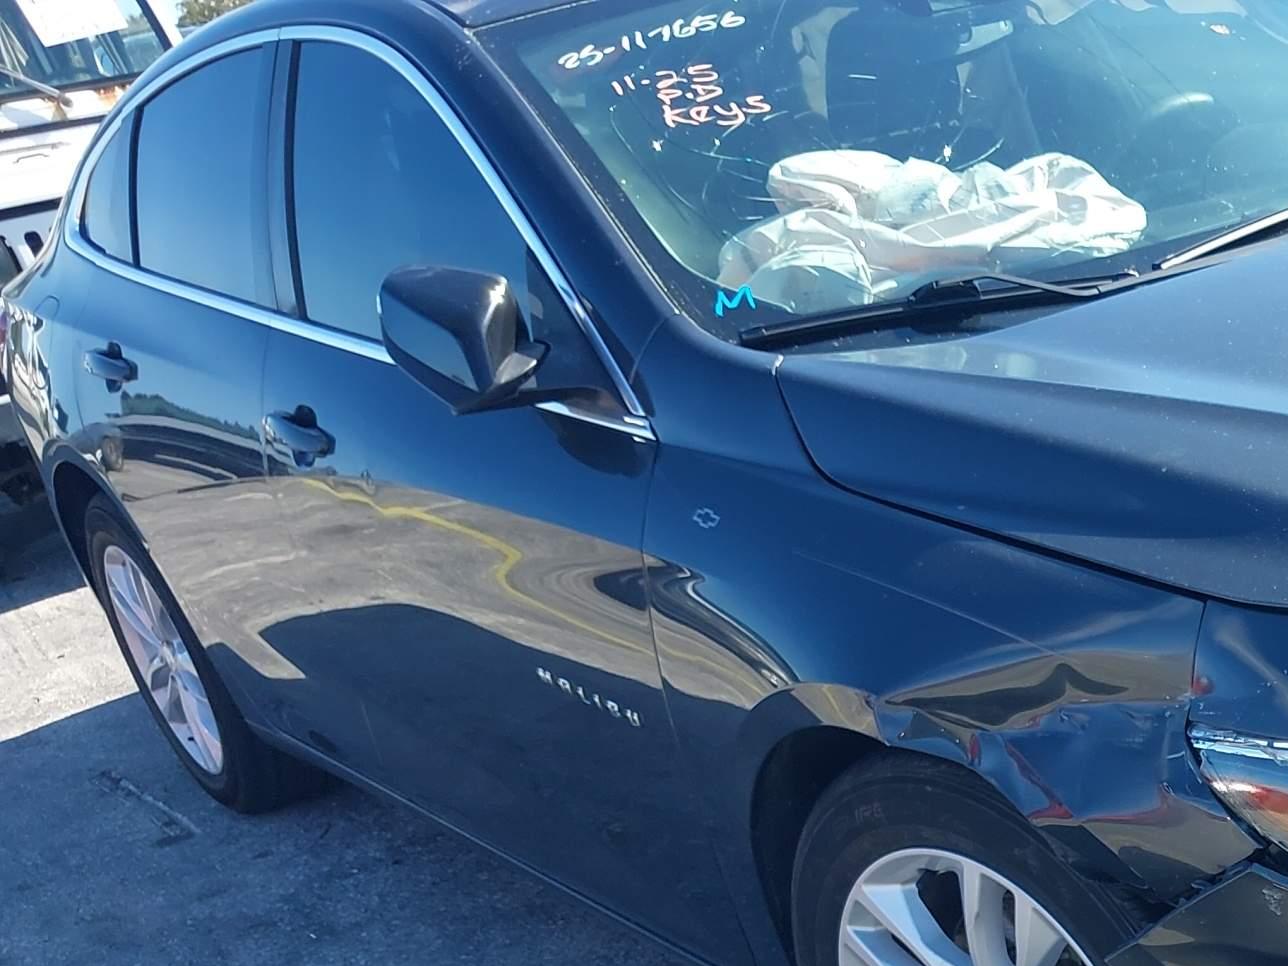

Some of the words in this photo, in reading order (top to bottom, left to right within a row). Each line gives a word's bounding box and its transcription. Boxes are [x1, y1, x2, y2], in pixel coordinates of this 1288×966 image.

[611, 64, 719, 96] 11-25
[715, 285, 756, 317] M
[536, 667, 640, 727] MALIBU
